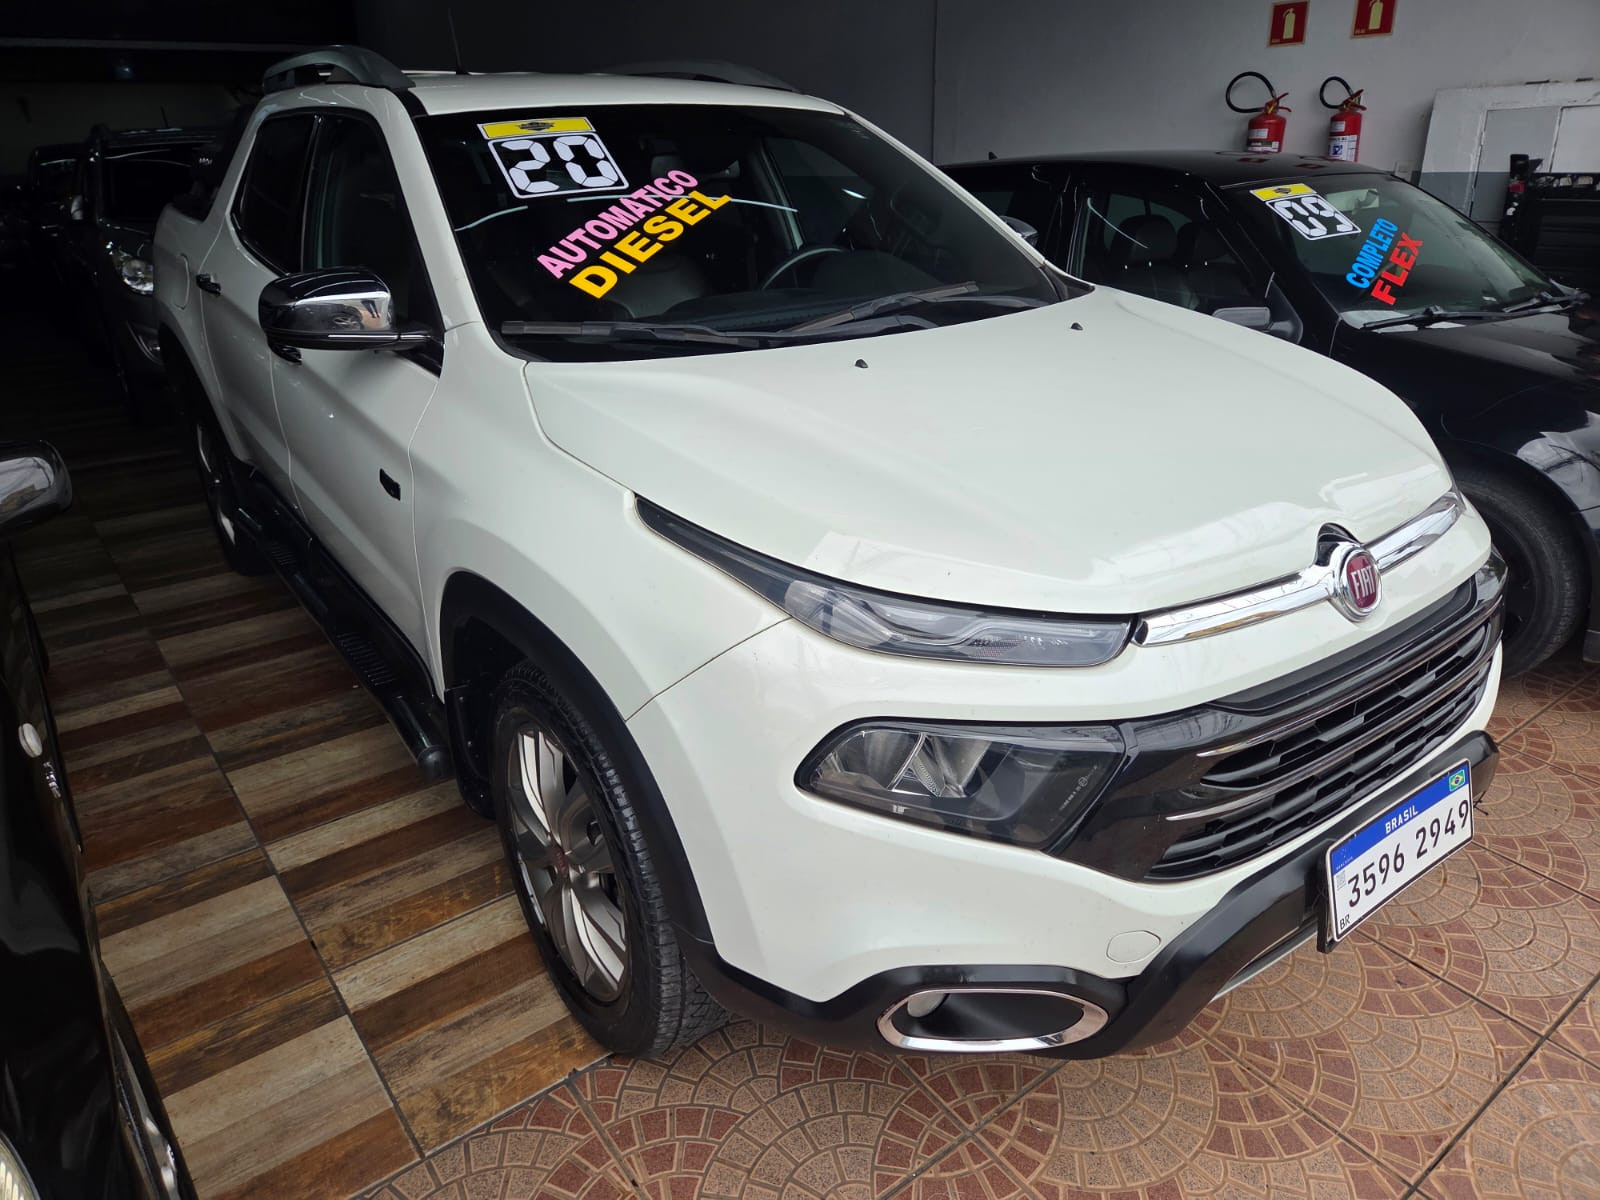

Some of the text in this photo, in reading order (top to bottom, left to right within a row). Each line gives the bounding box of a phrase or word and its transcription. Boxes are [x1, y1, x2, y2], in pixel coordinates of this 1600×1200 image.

[500, 136, 619, 193] 20
[537, 170, 699, 279] AUTOMATICO
[569, 190, 732, 299] DIESEL
[1345, 217, 1398, 289] COMPLETO
[1371, 232, 1423, 305] FLEX
[1350, 565, 1375, 599] FIAT
[1347, 799, 1469, 908] 3596 2949
[1385, 805, 1418, 834] BRASIL
[1339, 914, 1350, 930] BR
